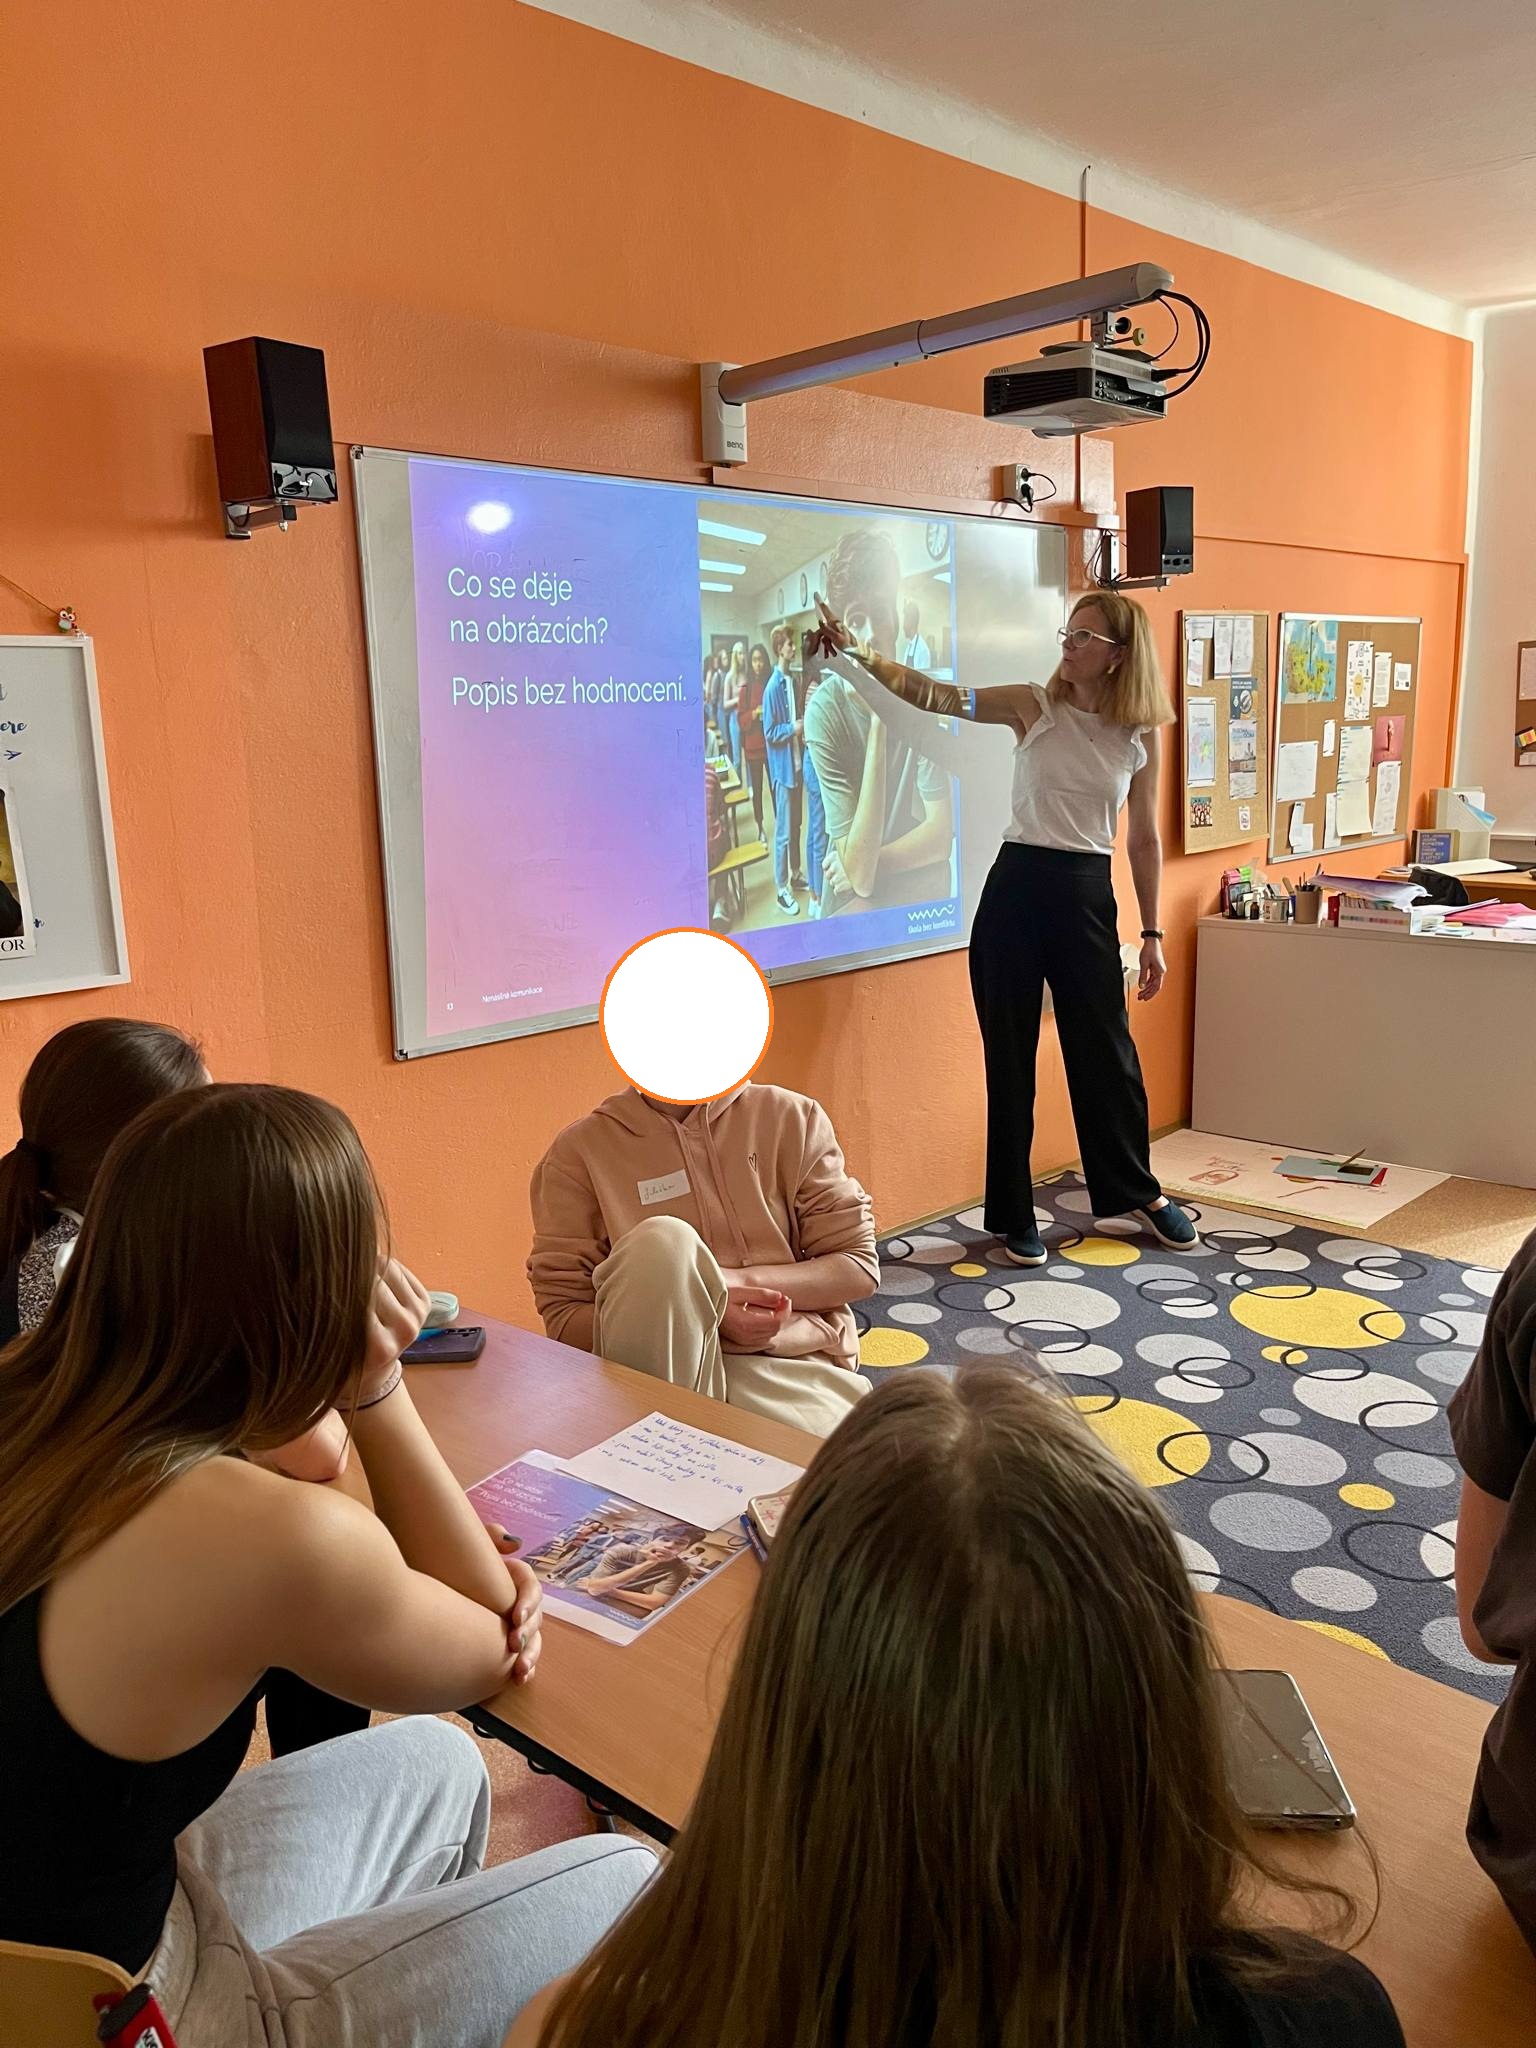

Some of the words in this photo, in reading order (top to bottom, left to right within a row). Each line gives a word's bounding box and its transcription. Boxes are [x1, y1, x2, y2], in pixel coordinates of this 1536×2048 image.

[448, 567, 482, 598] Co
[489, 575, 516, 598] se
[523, 570, 573, 606] děje
[450, 619, 480, 643] na
[486, 614, 609, 645] obrázcích?
[452, 676, 519, 713] Popis
[524, 676, 567, 706] bez
[572, 674, 687, 705] hodnocení.
[0, 721, 28, 735] ere
[0, 939, 27, 952] OR
